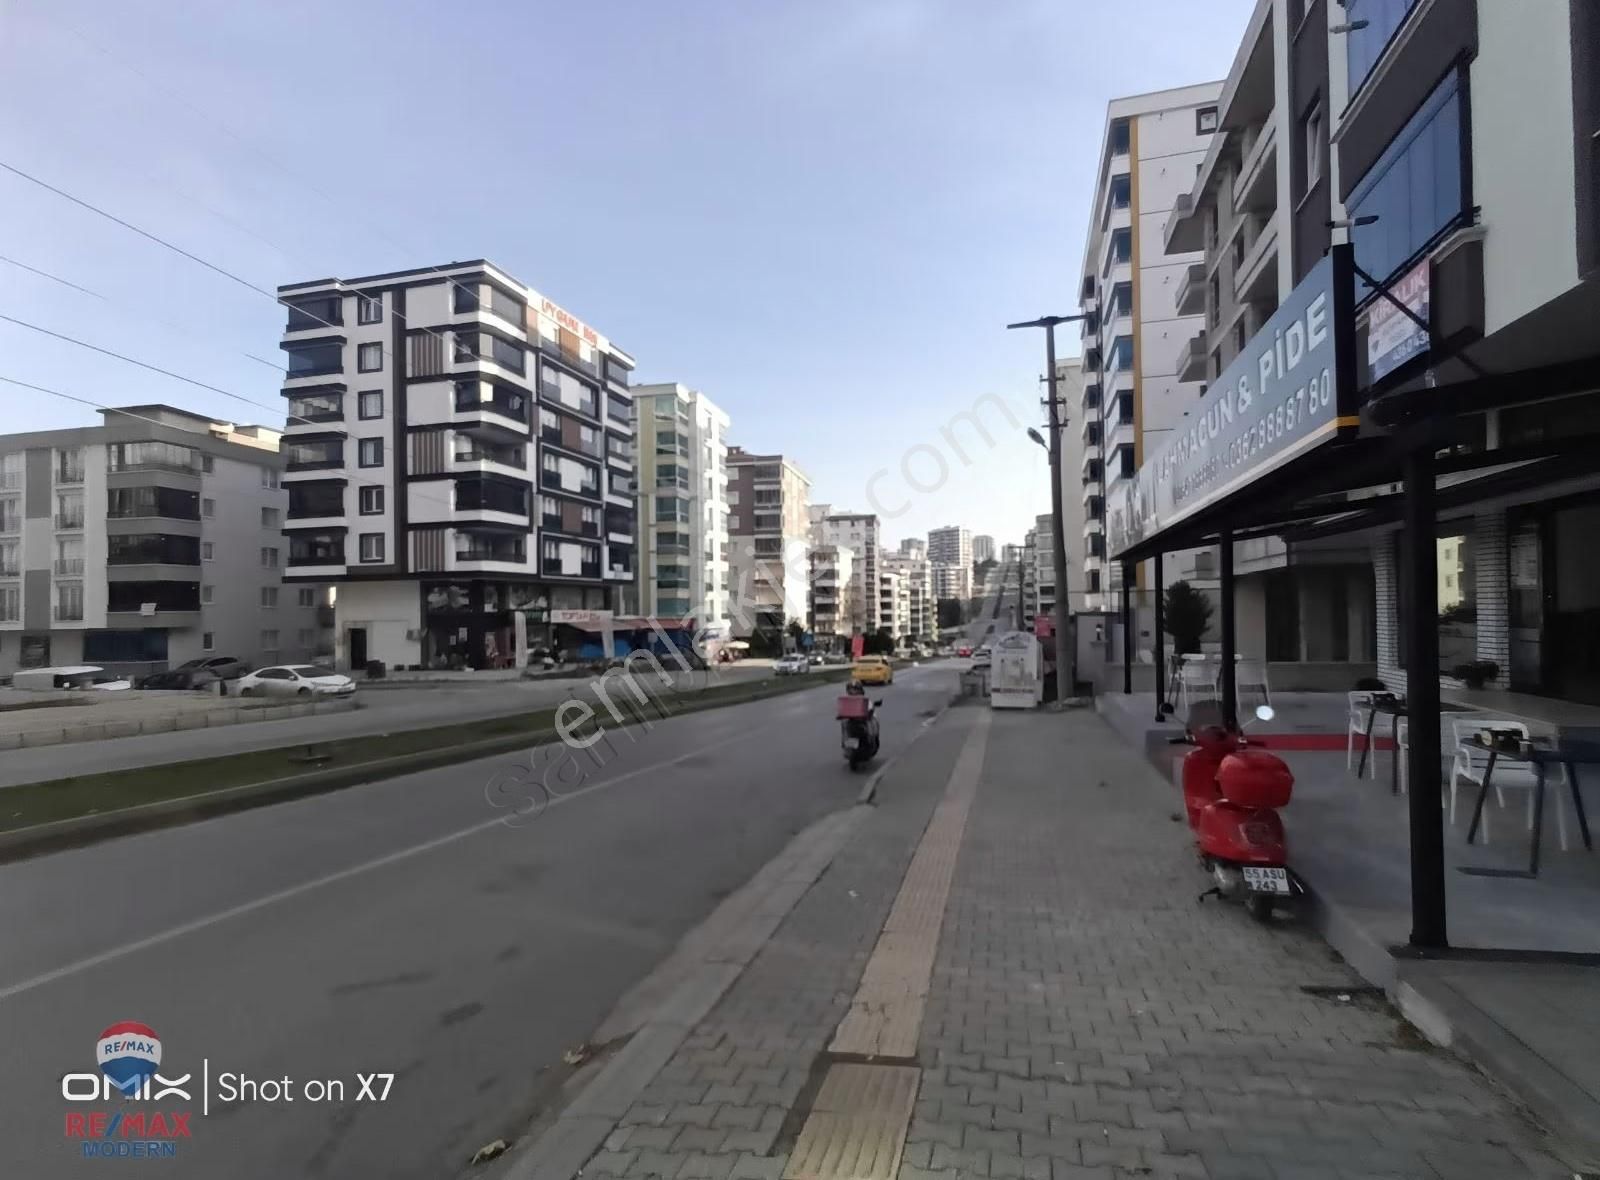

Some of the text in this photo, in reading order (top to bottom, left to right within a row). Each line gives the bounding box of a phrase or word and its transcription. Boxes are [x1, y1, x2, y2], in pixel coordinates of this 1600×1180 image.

[1238, 375, 1252, 414] &
[1258, 290, 1328, 394] PİDE
[1244, 868, 1285, 880] 55 ASU
[1256, 880, 1278, 891] 243
